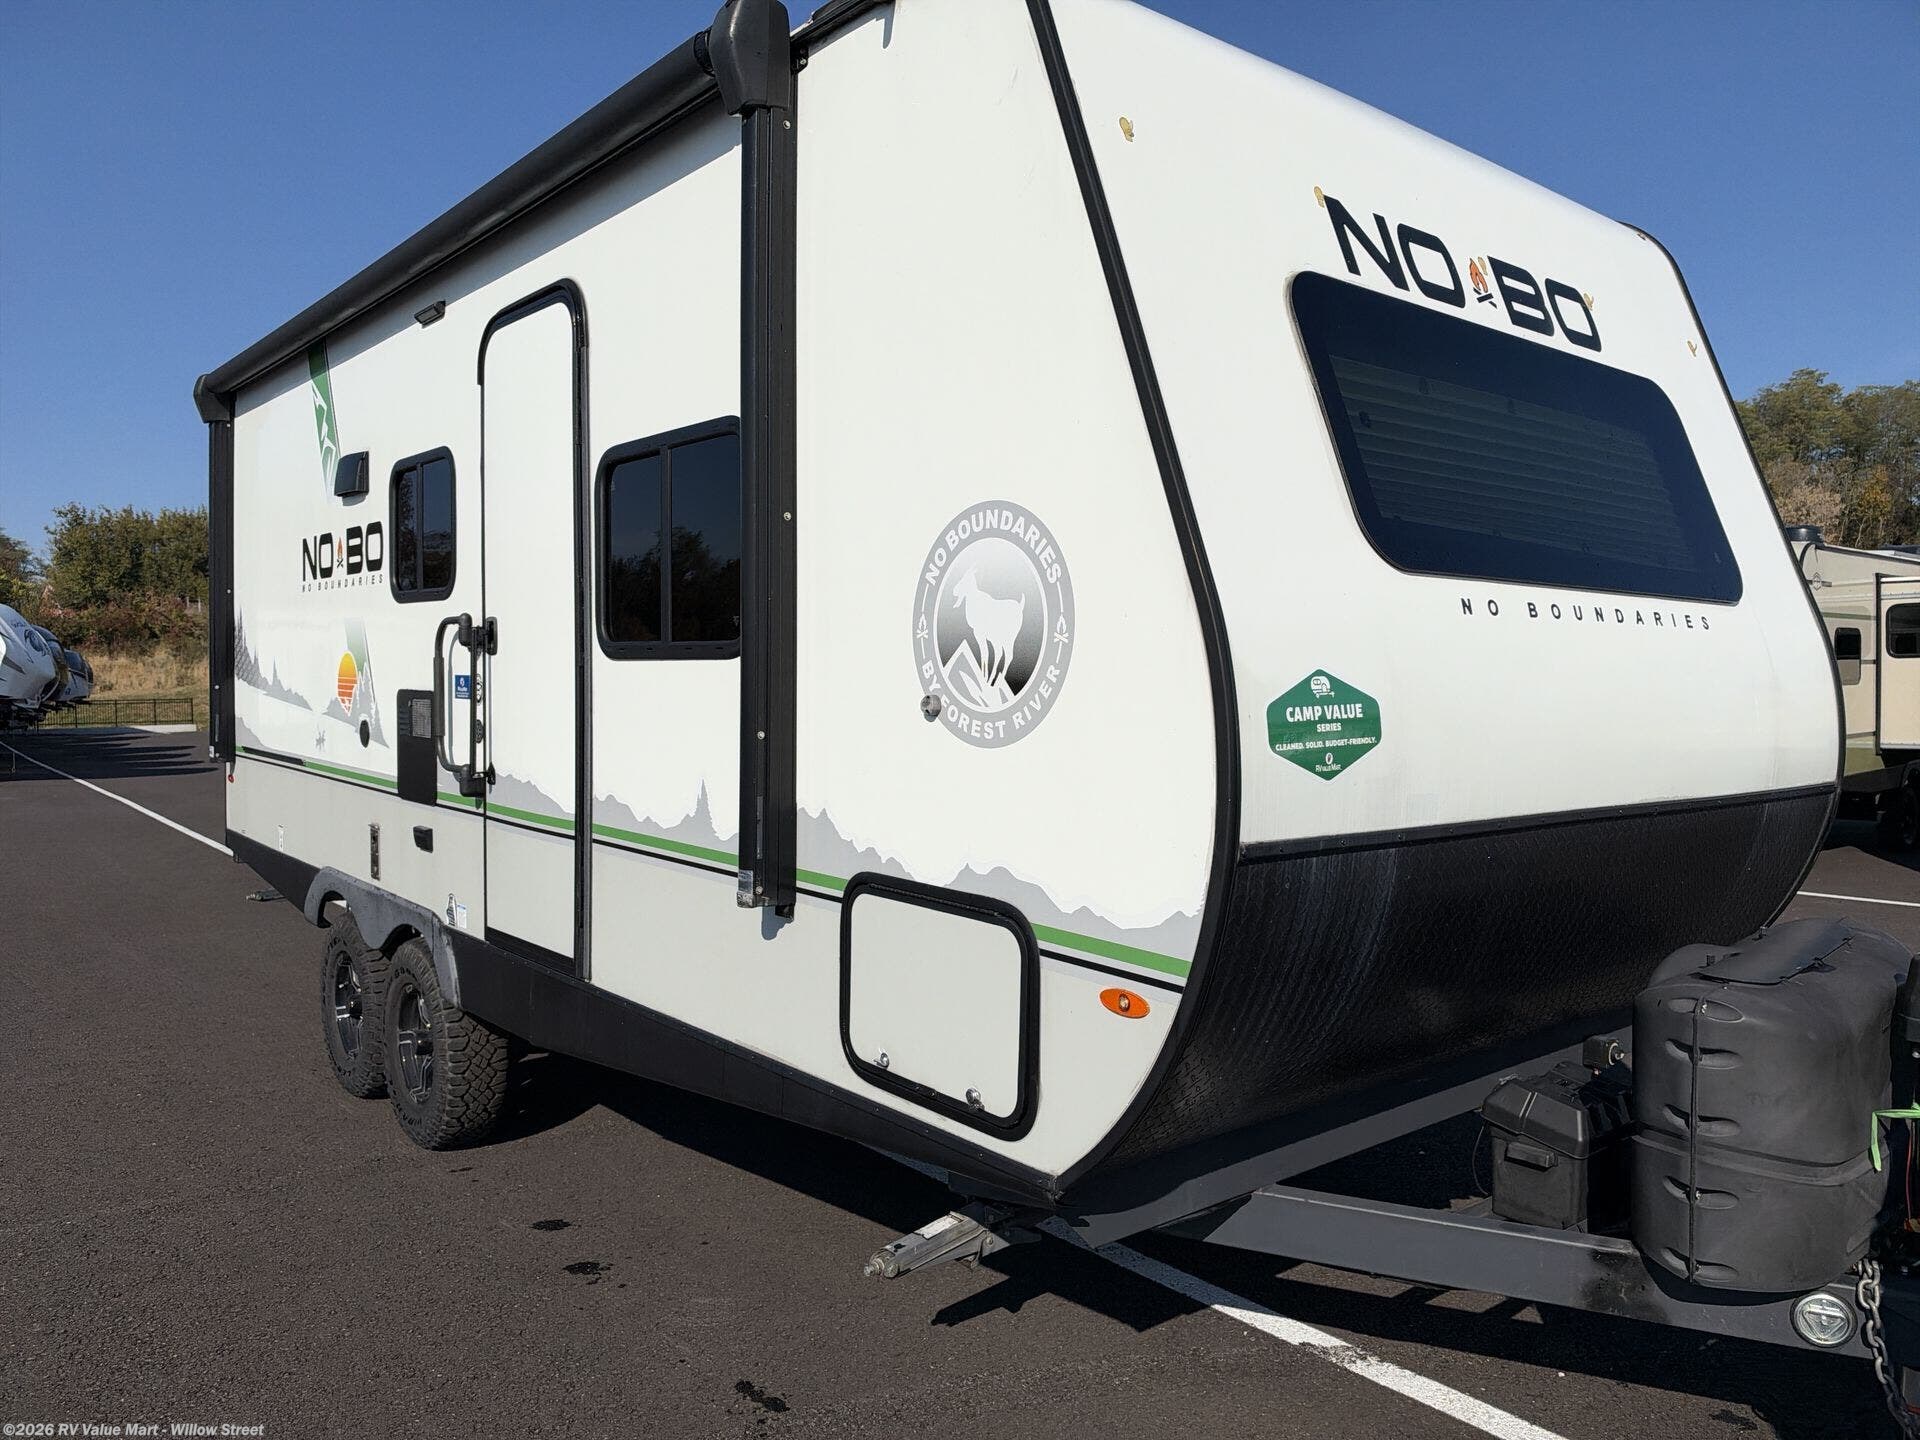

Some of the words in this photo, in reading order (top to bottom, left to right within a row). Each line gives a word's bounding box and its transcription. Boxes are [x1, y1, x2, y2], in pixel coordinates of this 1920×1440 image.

[925, 549, 947, 587] NO
[946, 509, 1062, 584] BOUNDARIES
[317, 574, 383, 591] BOUNDARIES
[1461, 598, 1499, 616] NO
[1527, 602, 1710, 630] BOUNDARIES
[922, 660, 942, 692] BY
[1013, 667, 1060, 730] RIVER
[1286, 706, 1322, 722] CAMP
[1324, 703, 1363, 720] VALUE
[1316, 723, 1341, 732] SERIES
[1325, 736, 1377, 748] BUDGET-FRIENDLY.
